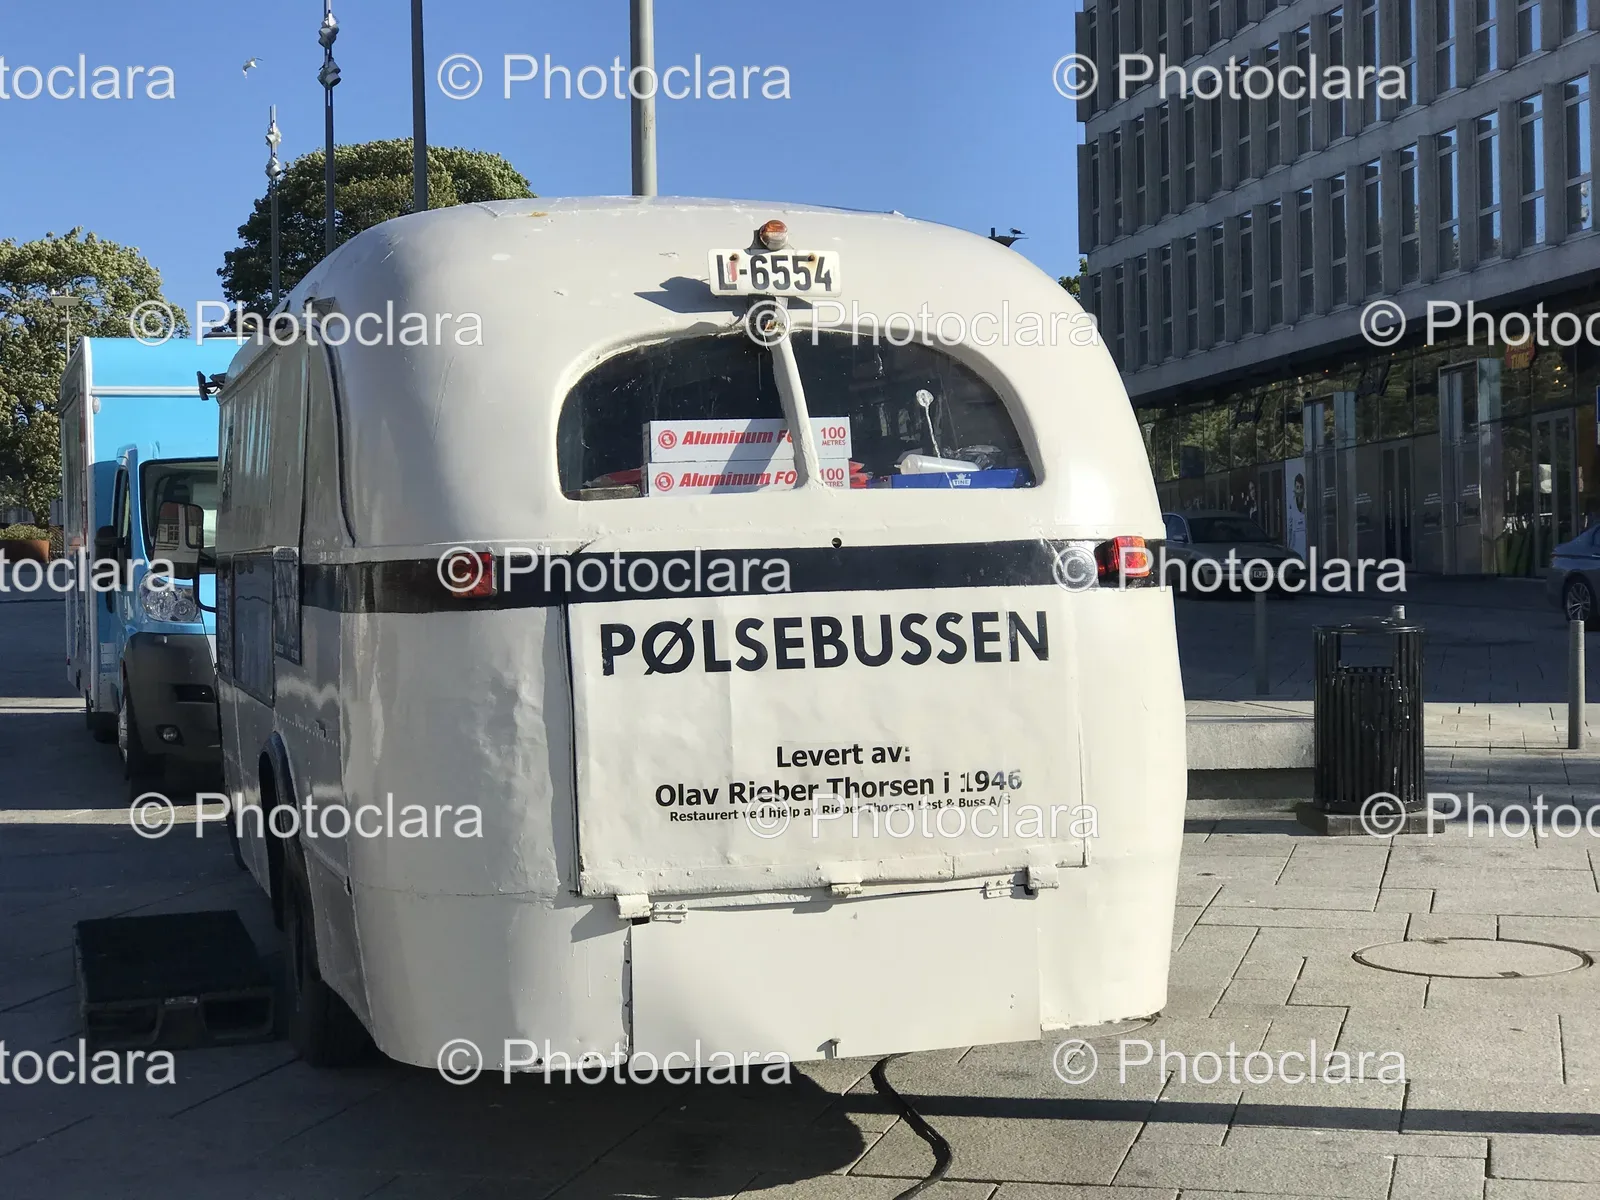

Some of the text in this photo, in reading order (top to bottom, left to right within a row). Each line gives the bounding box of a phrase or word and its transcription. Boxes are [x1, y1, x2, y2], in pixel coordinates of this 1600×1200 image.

[716, 254, 832, 291] L-6554
[682, 429, 773, 445] Aluminum
[821, 427, 846, 439] 100
[679, 471, 771, 487] Aluminum
[820, 468, 844, 480] 100
[600, 611, 1050, 677] PØLSEBUSSEN
[776, 744, 911, 768] Levert av:
[655, 769, 1023, 807] Olav Rieber Thorsen i 1946
[670, 809, 739, 822] Restaurert
[743, 808, 765, 819] ved
[769, 806, 800, 819] hjelp
[822, 804, 862, 815] Rieber
[867, 803, 914, 814] Thorsen
[959, 798, 985, 808] Buss
